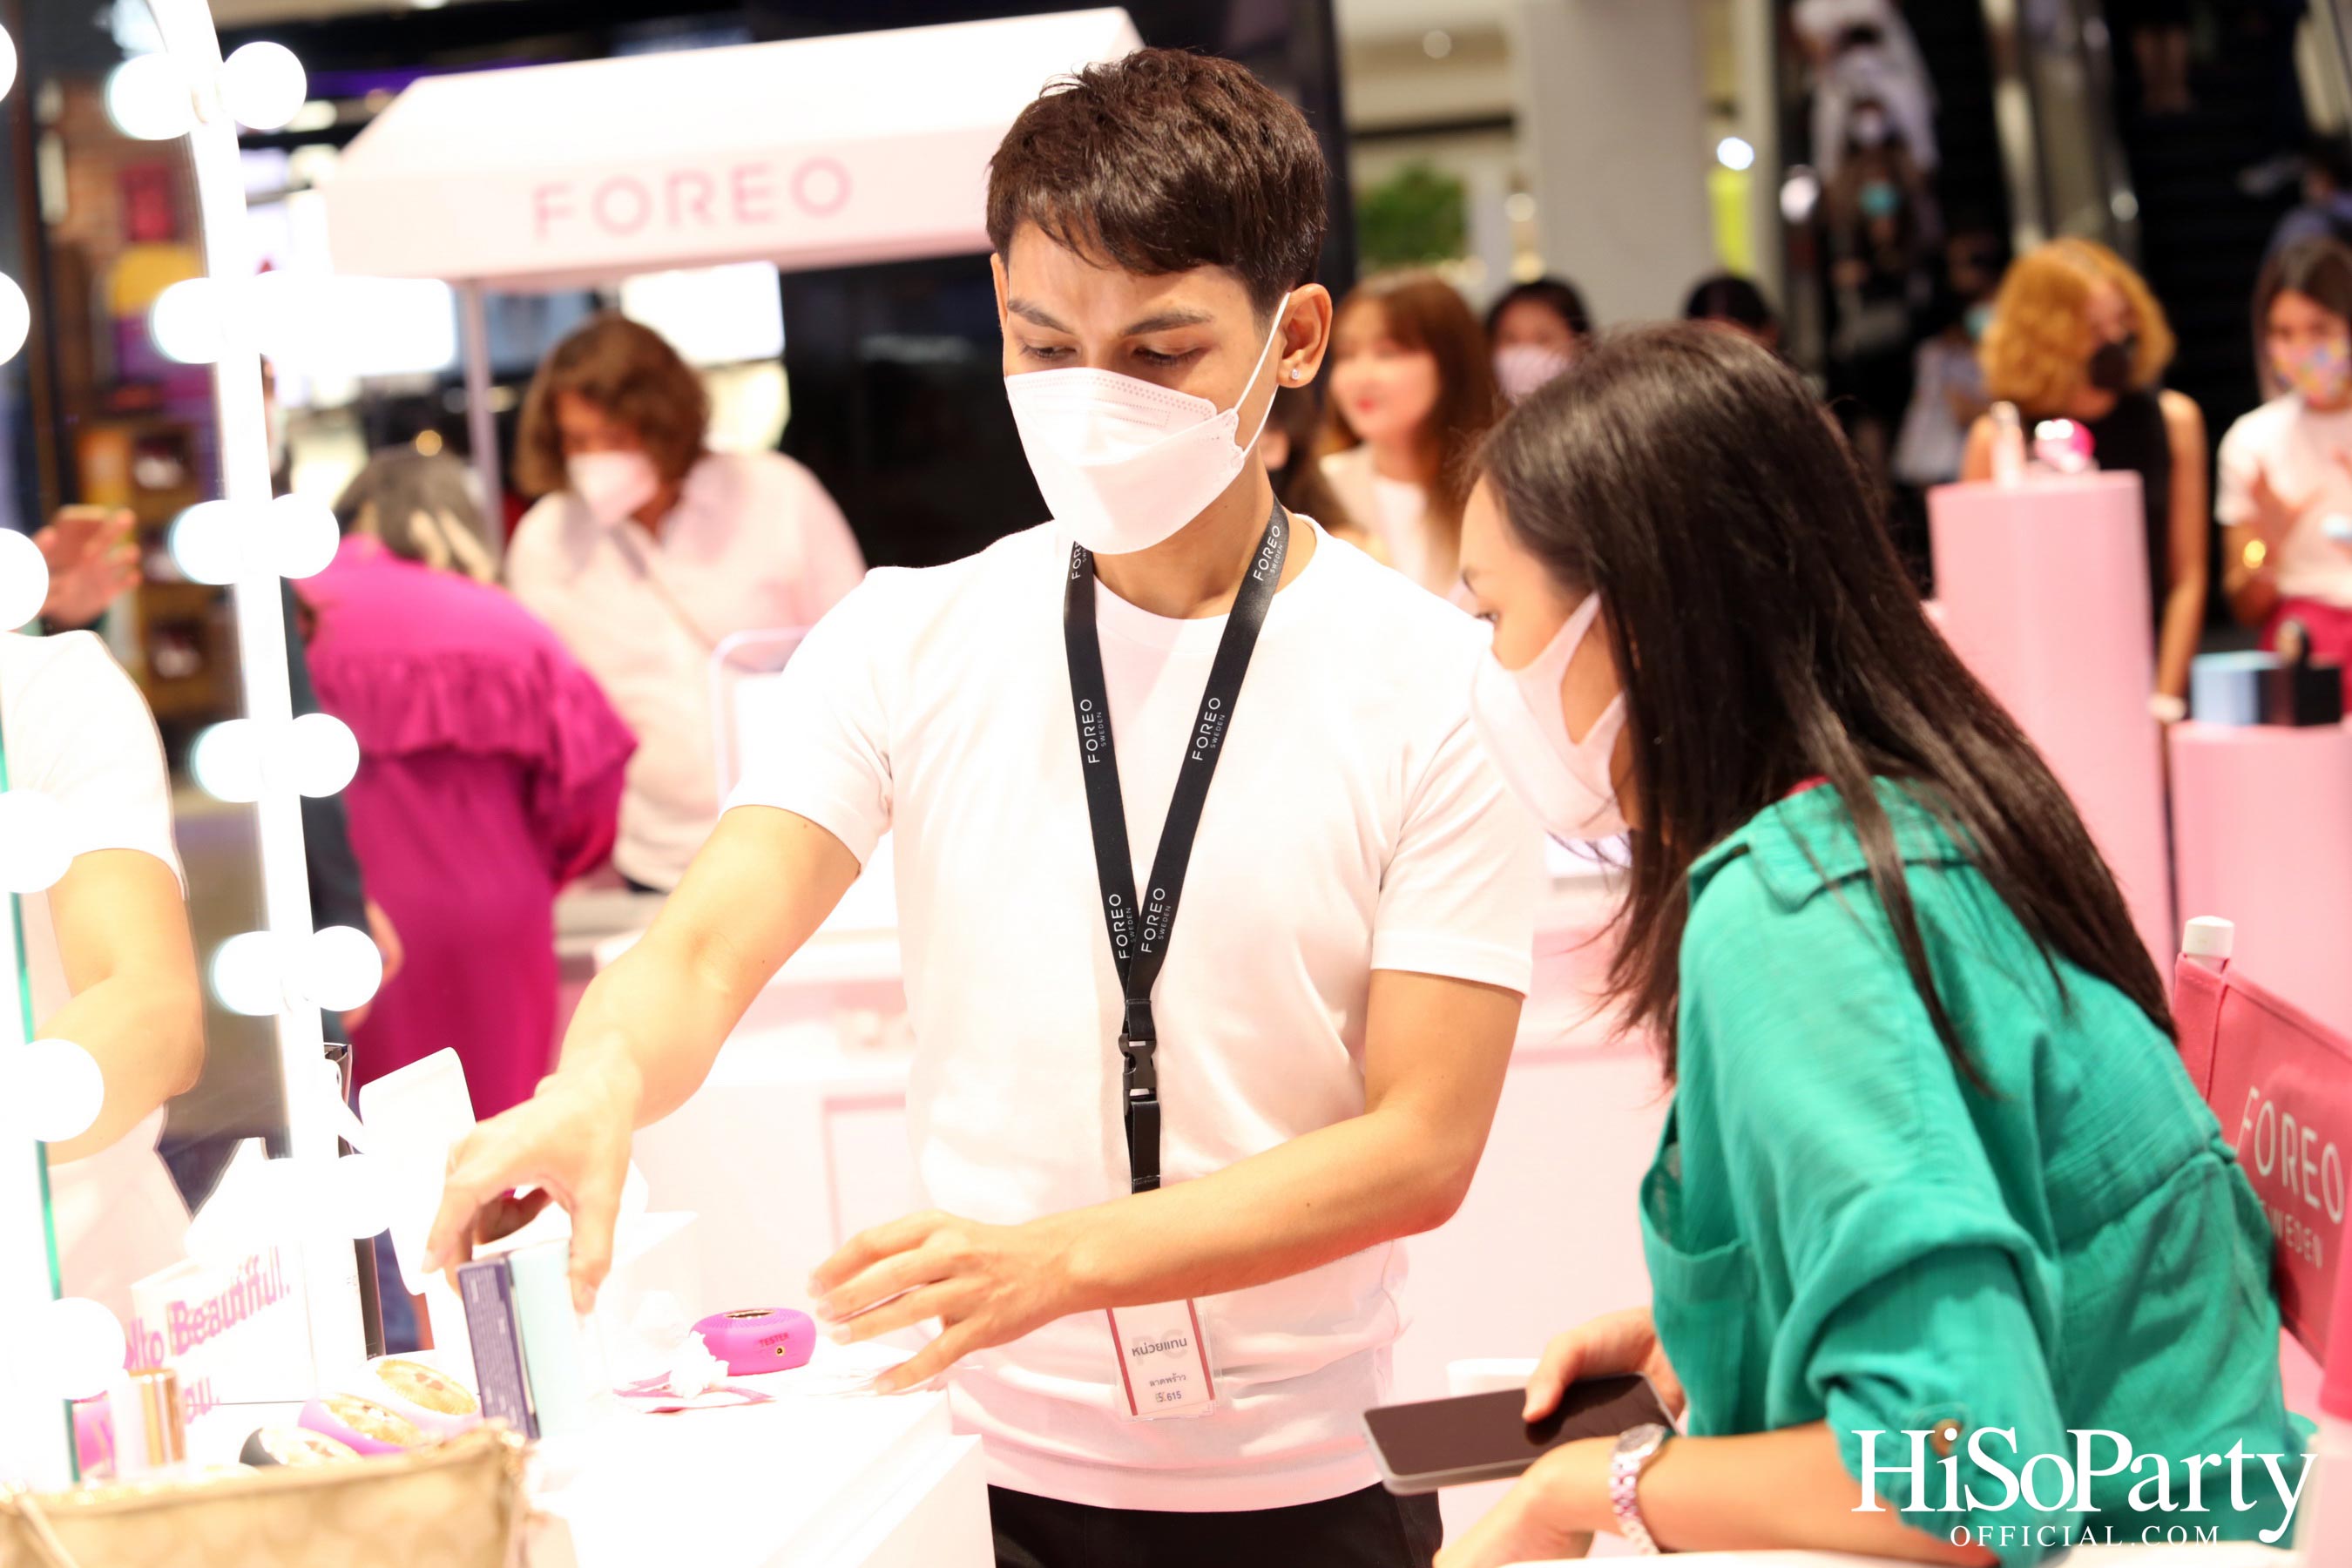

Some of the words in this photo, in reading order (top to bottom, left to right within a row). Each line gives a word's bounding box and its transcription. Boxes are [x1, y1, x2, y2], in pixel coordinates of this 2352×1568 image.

[532, 155, 853, 240] FOREO
[1253, 525, 1281, 582] FOREO
[1270, 544, 1283, 574] SWEDEN
[1079, 699, 1100, 764] FOREO
[1096, 712, 1107, 747] SWEDEN
[1192, 697, 1220, 761] FOREO
[1210, 714, 1226, 749] SWEDEN
[1108, 894, 1130, 959] FOREO
[1140, 888, 1166, 953] FOREO
[1158, 905, 1172, 940] SWEDEN
[2235, 1085, 2345, 1225] FOREO
[759, 1332, 789, 1348] TESTER
[1132, 1338, 1187, 1357] หน่วยแทน
[1166, 1390, 1182, 1402] 615
